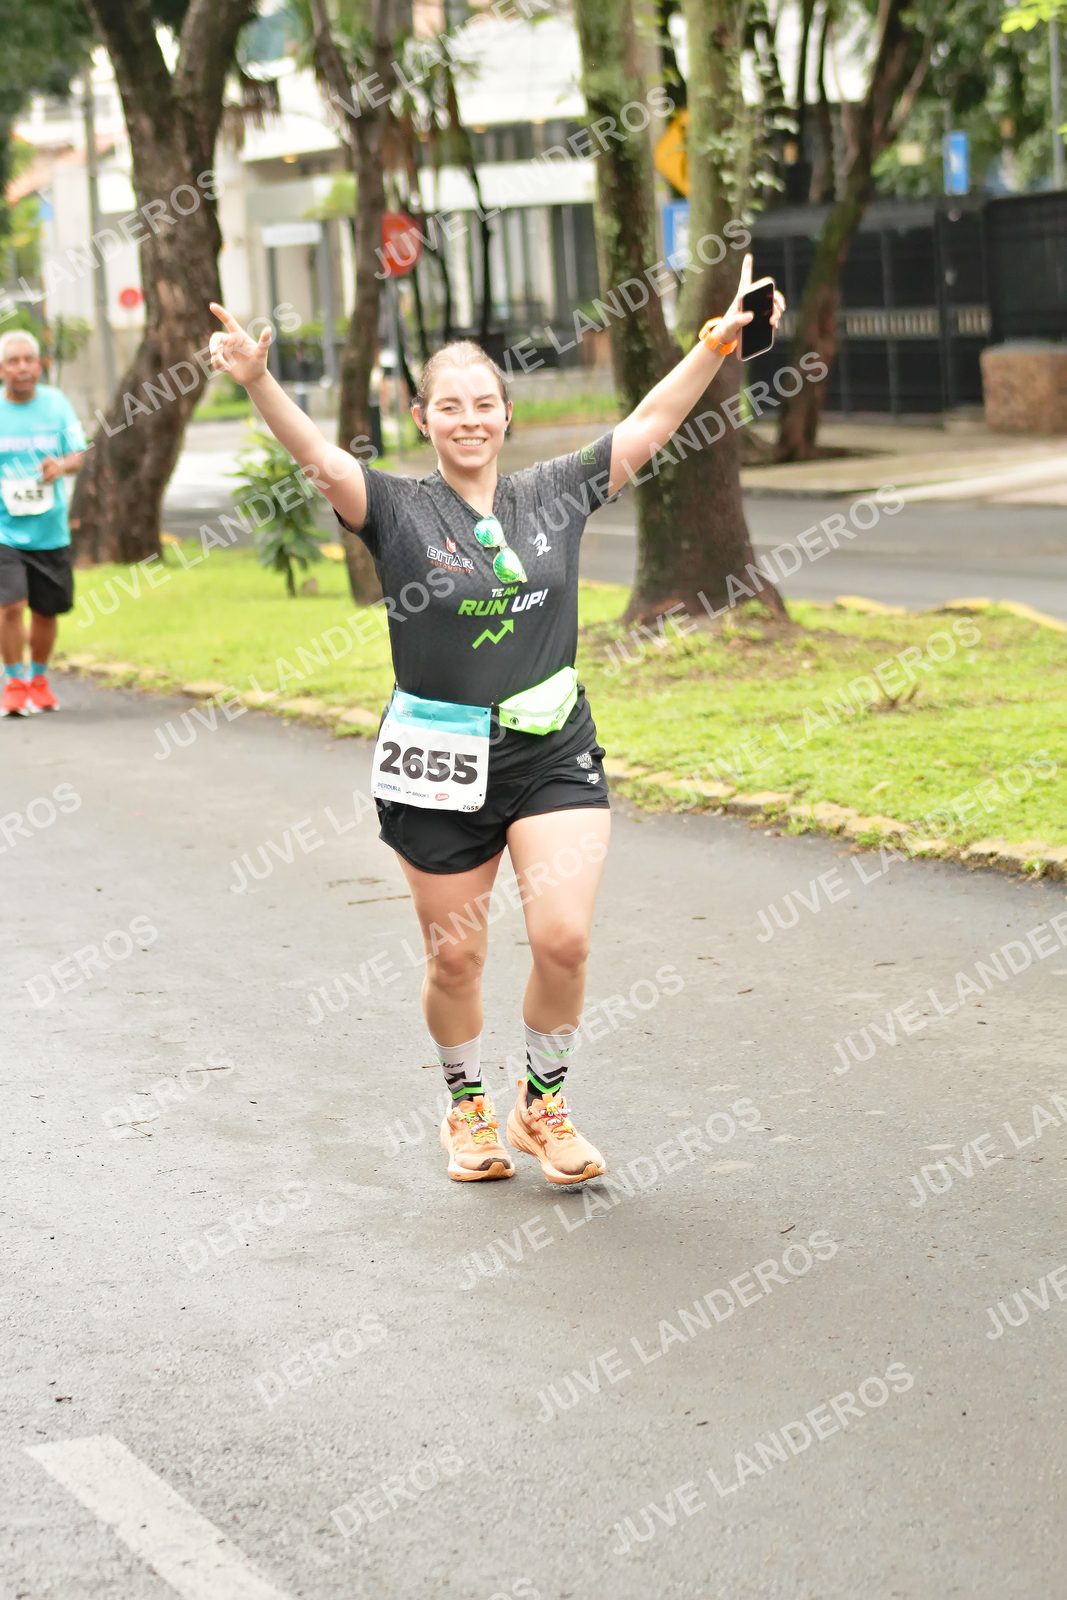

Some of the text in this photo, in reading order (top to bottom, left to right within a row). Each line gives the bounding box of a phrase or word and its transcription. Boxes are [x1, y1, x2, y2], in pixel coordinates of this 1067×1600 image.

[427, 545, 474, 570] BITAR
[458, 588, 549, 617] RUN UP!
[491, 586, 519, 598] TEAM
[380, 741, 478, 785] 2655
